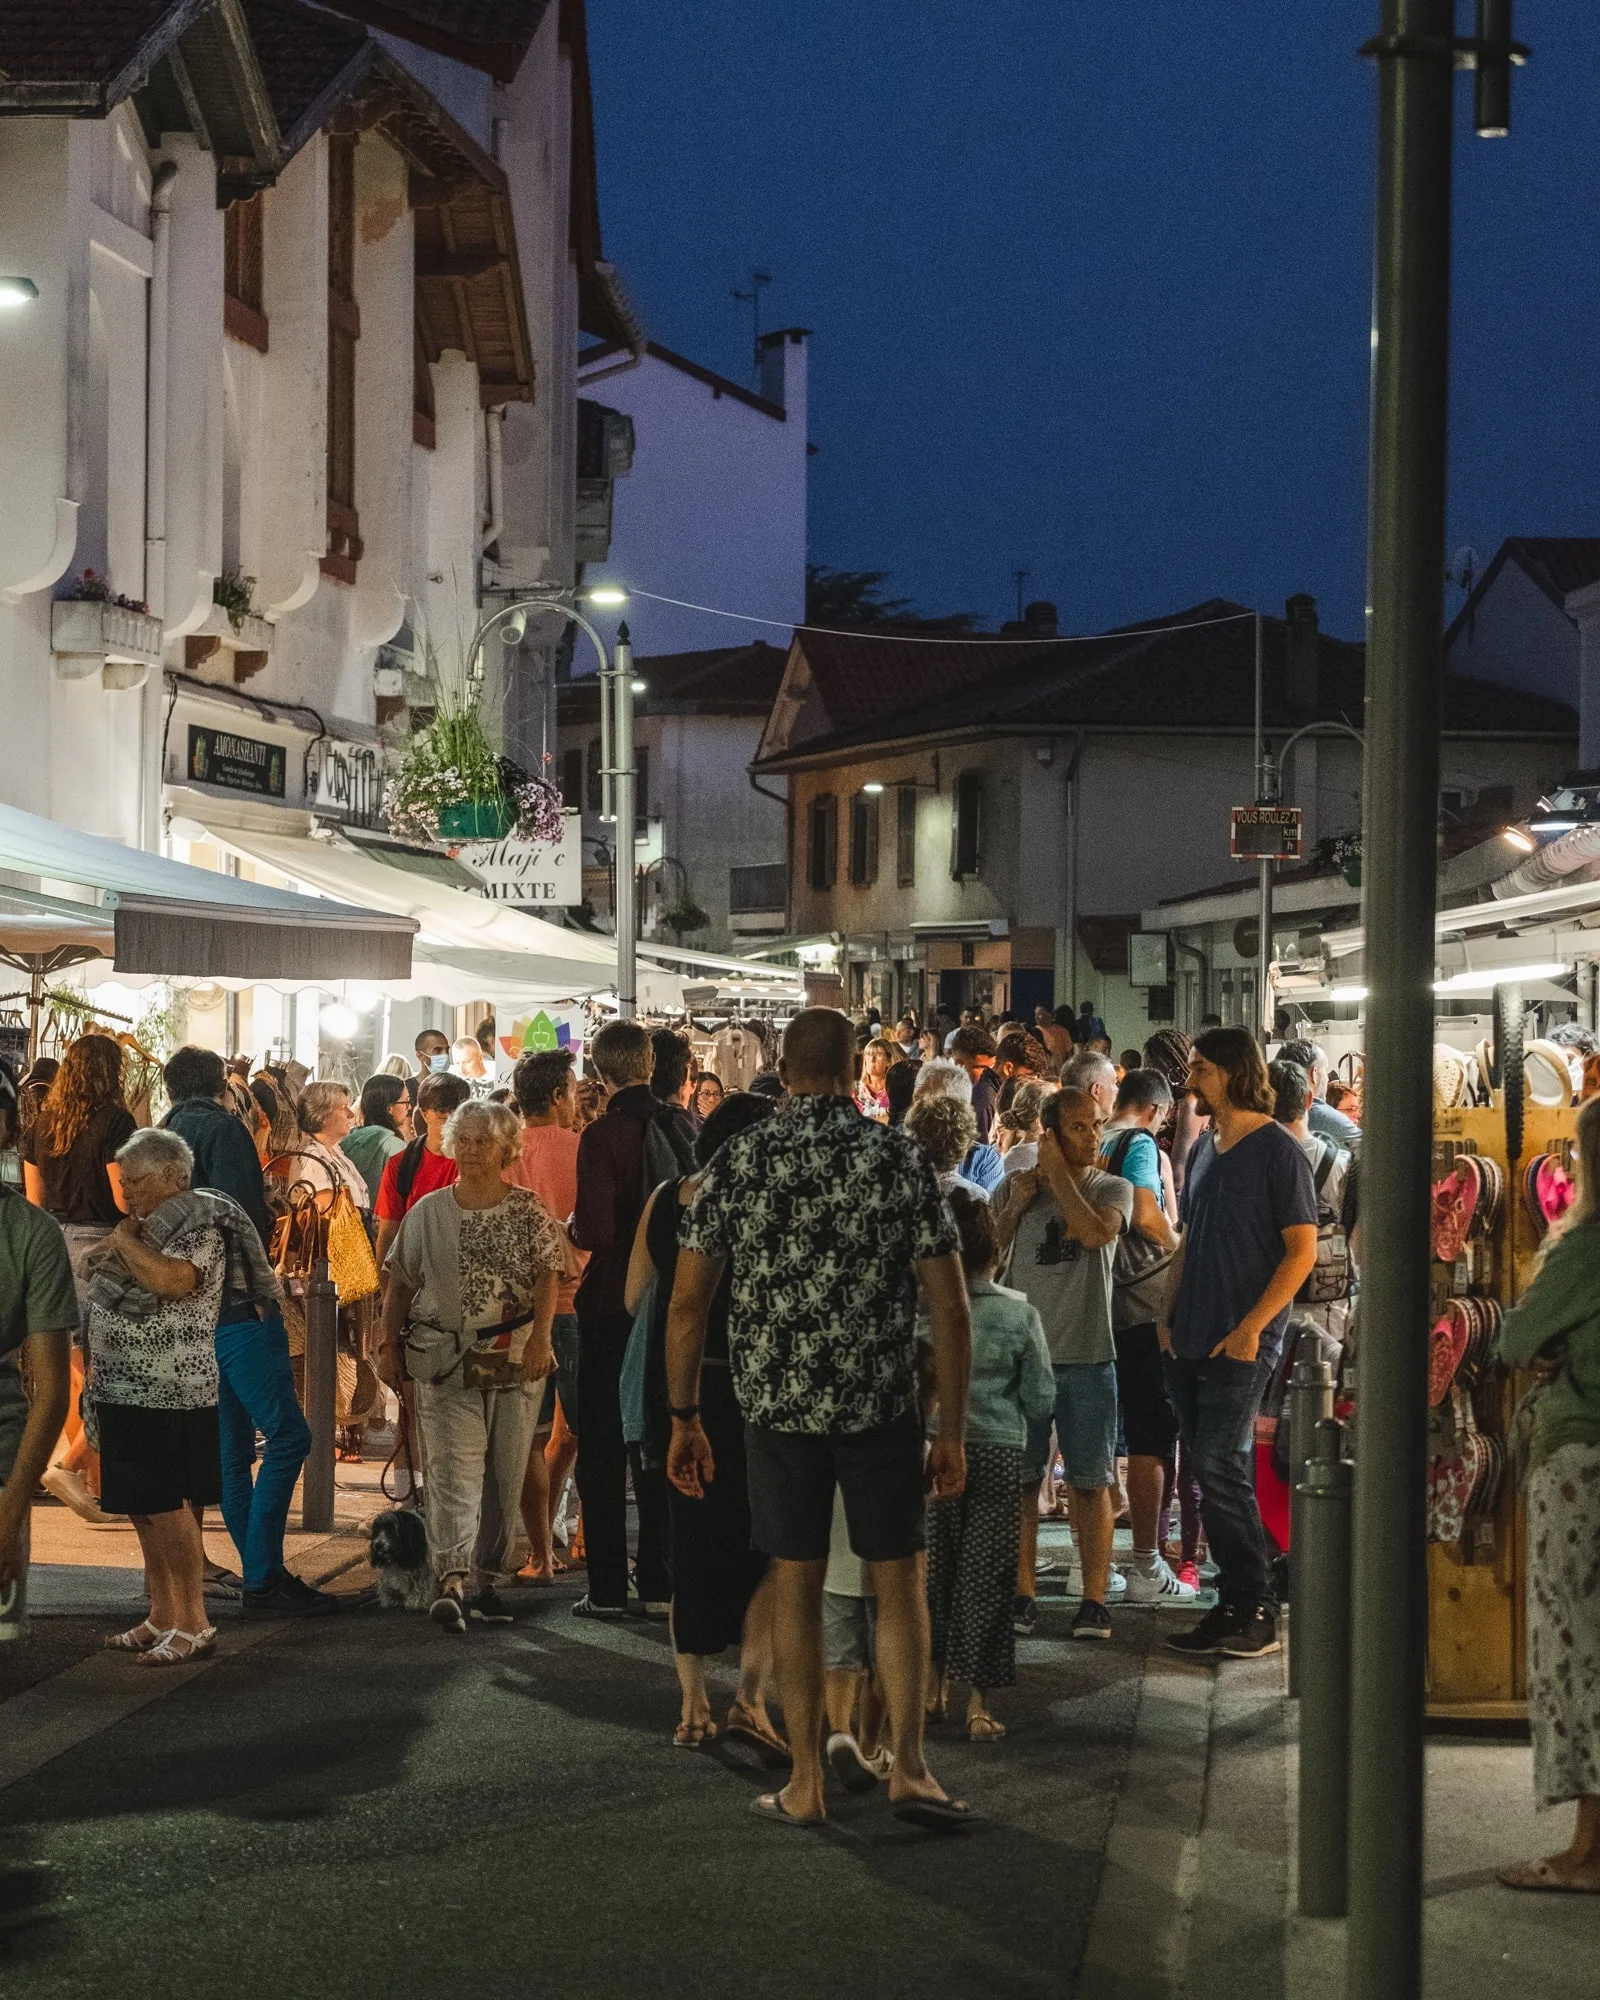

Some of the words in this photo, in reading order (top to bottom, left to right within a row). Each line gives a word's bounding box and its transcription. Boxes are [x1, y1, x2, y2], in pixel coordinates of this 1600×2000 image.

[213, 734, 267, 766] AMONASHANTI
[1236, 811, 1257, 823] VOUS
[1259, 811, 1290, 824] ROULEZ
[1283, 828, 1297, 837] km
[1287, 841, 1293, 850] h
[480, 882, 556, 899] MIXTE
